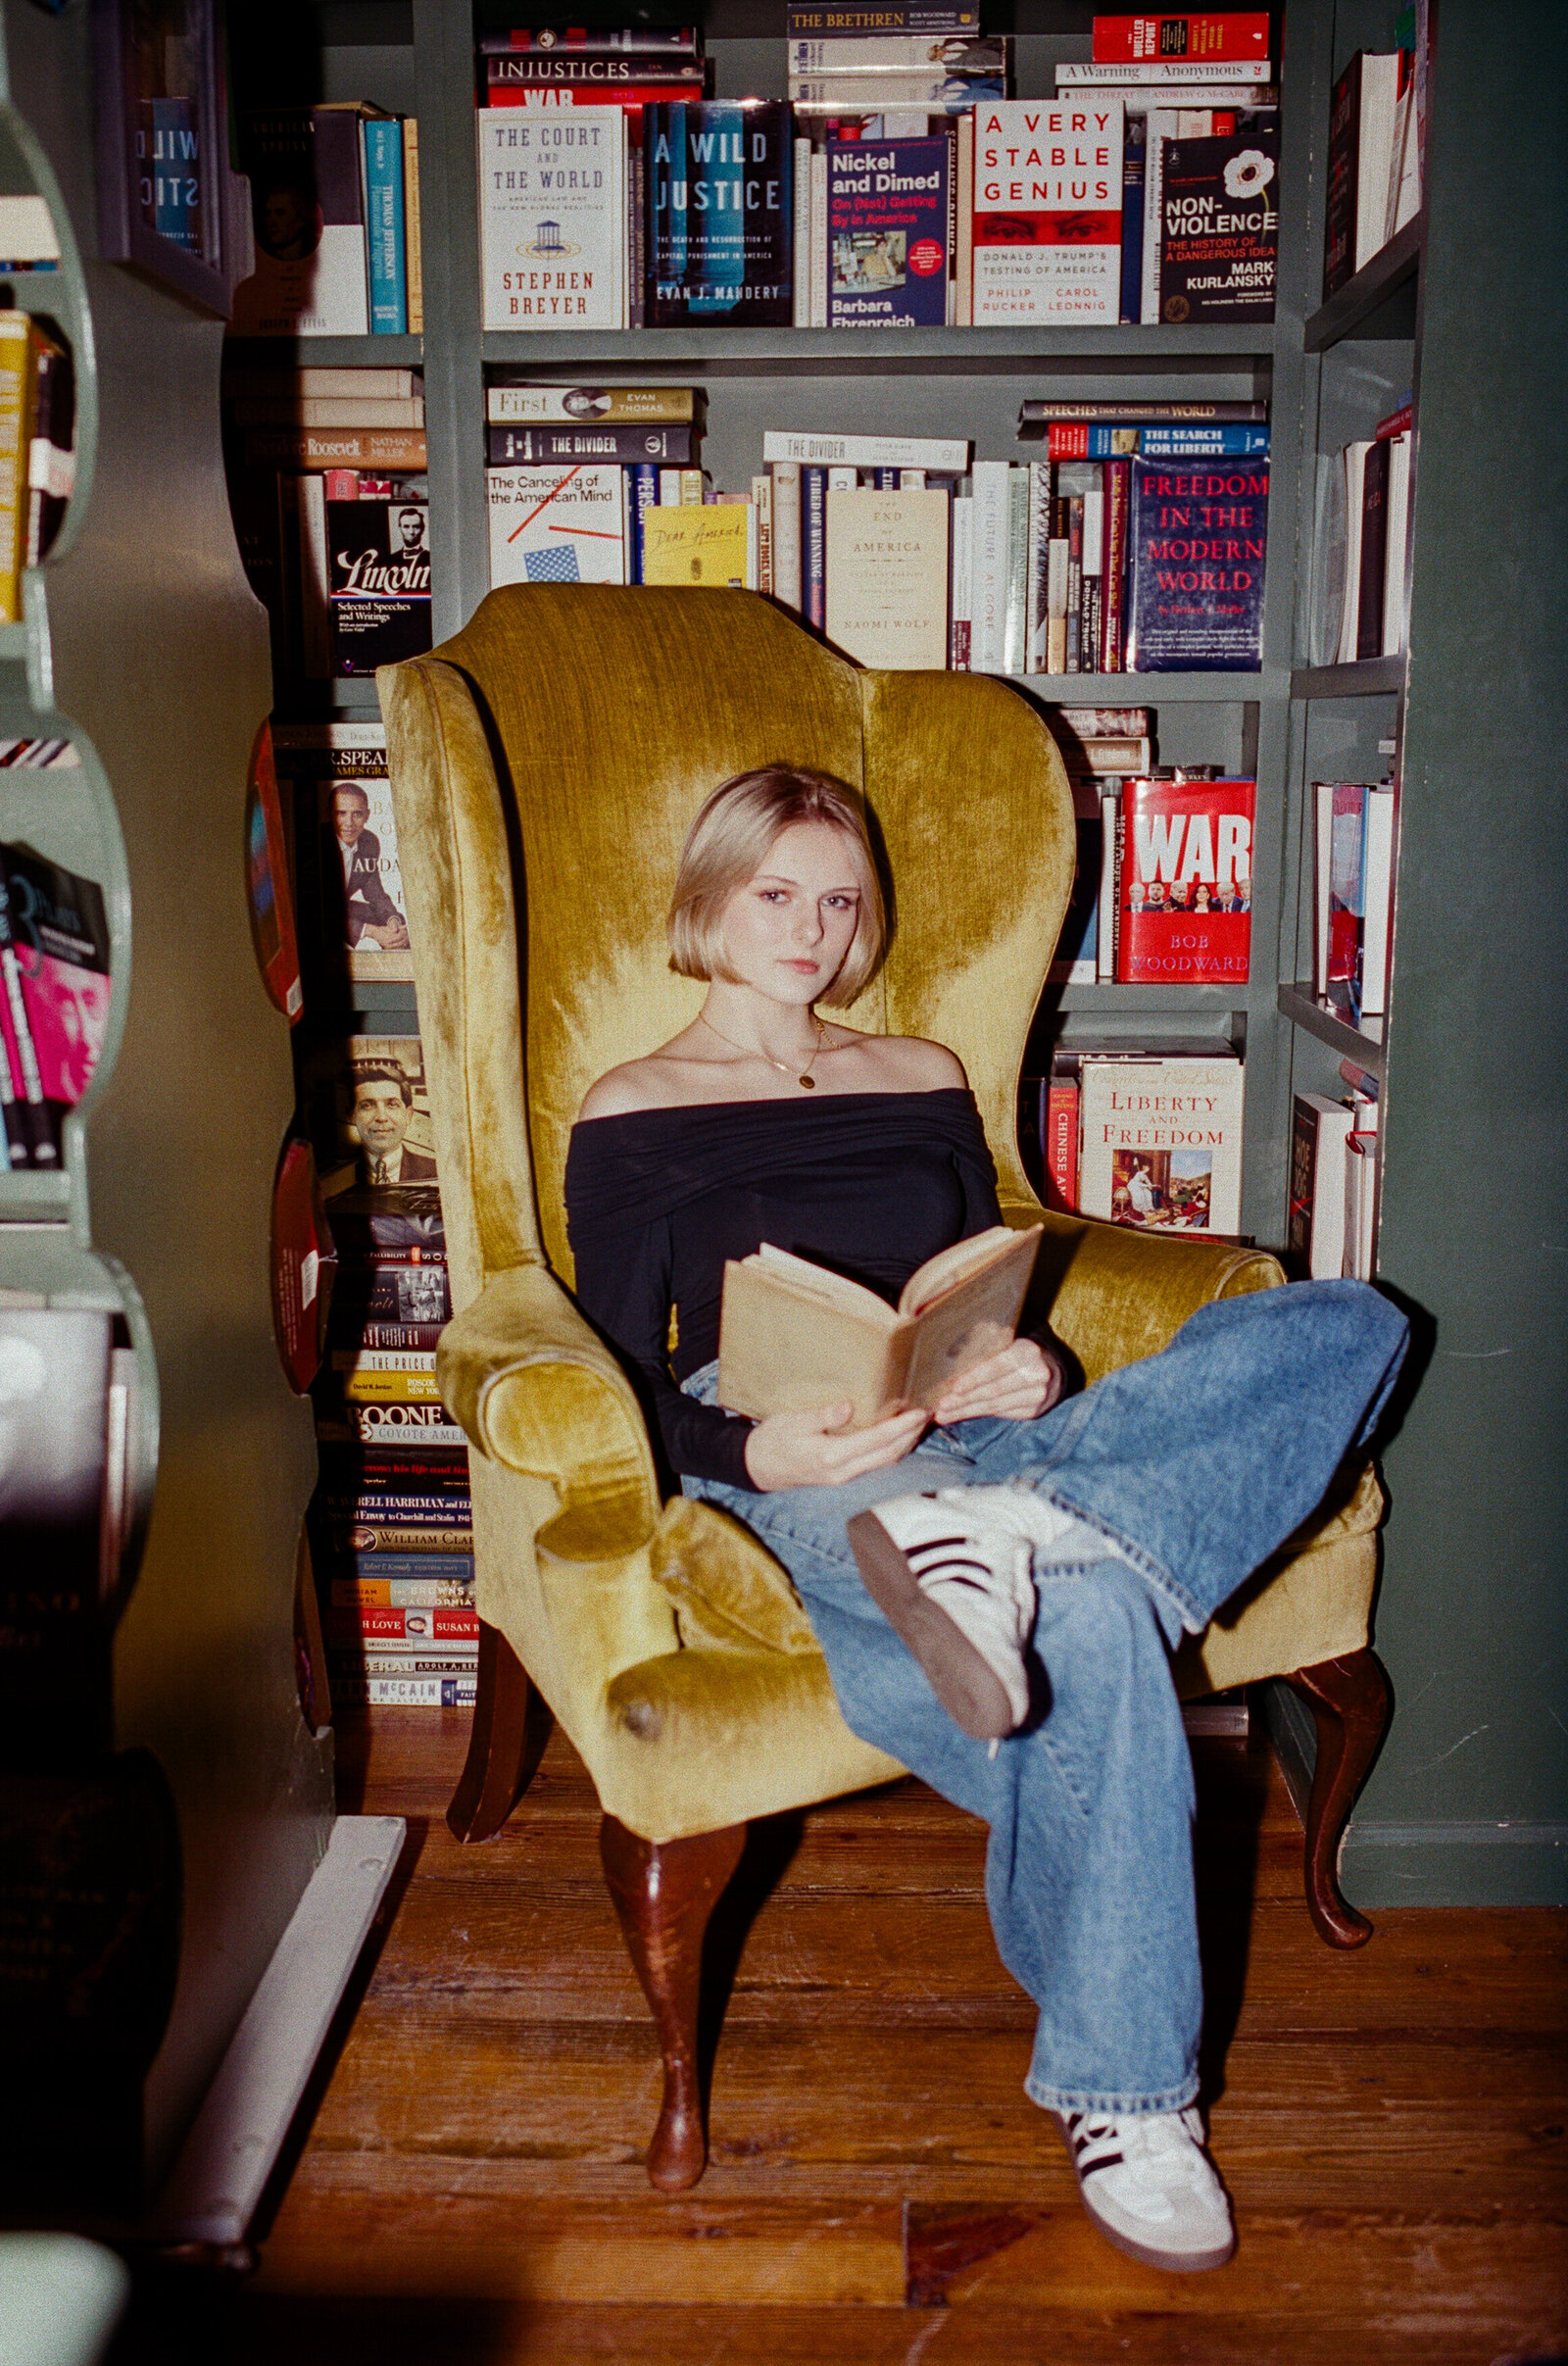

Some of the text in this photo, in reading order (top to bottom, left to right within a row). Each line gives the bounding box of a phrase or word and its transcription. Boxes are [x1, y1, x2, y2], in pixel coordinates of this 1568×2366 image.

[792, 12, 905, 27] THE BRETHREN
[1133, 19, 1145, 58] MUELLER
[1145, 22, 1156, 55] REPORT
[498, 62, 630, 79] INJUSTICES
[1065, 65, 1243, 79] A Warning Anonymous
[523, 89, 573, 107] WAR
[985, 113, 1109, 133] A VERY
[496, 127, 602, 147] THE COURT
[655, 133, 766, 163] A WILD
[537, 153, 559, 164] AND
[832, 152, 896, 173] Nickel
[985, 147, 1109, 168] STABLE
[494, 171, 603, 189] THE WORLD
[832, 171, 940, 193] and Dimed
[655, 180, 780, 211] JUSTICE
[984, 181, 1109, 201] GENIUS
[832, 195, 937, 212] On (Not) Getting
[1166, 197, 1223, 217] NON-
[832, 213, 917, 228] By in America
[1166, 212, 1278, 235] VIOLENCE
[382, 184, 396, 280] THOMAS JEFFERSON
[1166, 237, 1256, 251] THE HISTORY OF
[983, 253, 1033, 262] DONALD
[1054, 252, 1107, 261] TRUMP'S
[1165, 247, 1274, 262] A DANGEROUS IDEA
[983, 267, 1031, 275] TESTING
[1055, 266, 1106, 274] AMERICA
[1231, 262, 1273, 275] MARK
[503, 272, 593, 289] STEPHEN
[1187, 274, 1273, 290] KURLANSKY
[657, 286, 779, 300] EVAN J. MANDERY
[987, 289, 1031, 298] PHILIP
[1055, 288, 1098, 297] CAROL
[510, 297, 586, 314] BREYER
[832, 298, 892, 314] Barbara
[983, 303, 1035, 312] RUCKER
[1049, 302, 1106, 311] LEONNIG
[832, 315, 915, 327] Ehrenreich
[500, 392, 548, 413] First
[618, 404, 664, 413] THOMAS
[1043, 405, 1097, 417] SPEECHES
[1171, 406, 1216, 417] WORLD
[370, 437, 413, 447] NATHAN
[1144, 430, 1222, 440] THE SEARCH
[308, 438, 361, 458] Roosevelt
[551, 436, 572, 454] THE
[574, 436, 617, 454] DIVIDER
[787, 439, 846, 459] THE DIVIDER
[1144, 443, 1224, 454] FOR LIBERTY
[490, 476, 514, 488] The
[586, 474, 599, 486] of
[1143, 475, 1268, 497] FREEDOM
[491, 489, 612, 504] the American Mind
[873, 512, 903, 521] END
[1159, 507, 1253, 528] IN THE
[810, 475, 822, 578] TIRED OF WINNING
[984, 513, 996, 561] FUTURE
[854, 542, 921, 553] AMERICA
[1147, 539, 1263, 561] MODERN
[337, 549, 431, 598] Lincoln
[985, 573, 995, 586] AL
[1156, 571, 1251, 591] WORLD
[337, 602, 411, 613] Selected Speeches
[984, 593, 995, 629] GORE
[338, 612, 390, 623] and Writings
[844, 619, 930, 629] NAOMI WOLF
[341, 751, 388, 765] SPEA
[1133, 814, 1251, 883] WAR
[1170, 934, 1208, 949] BOB
[1130, 957, 1248, 971] WOODWARD
[1110, 1092, 1219, 1111] LIBERTY
[1150, 1115, 1179, 1124] AND
[1057, 1112, 1068, 1171] CHINESE
[1103, 1124, 1223, 1145] FREEDOM
[371, 1356, 429, 1370] THE PRICE
[407, 1378, 435, 1387] ROSCOE
[378, 1428, 426, 1440] COYOTE
[385, 1497, 445, 1508] HARRIMAN
[379, 1531, 438, 1545] WILLIAM
[411, 1587, 465, 1596] BROWNS
[372, 1621, 401, 1630] LOVE
[436, 1622, 470, 1632] SUSAN
